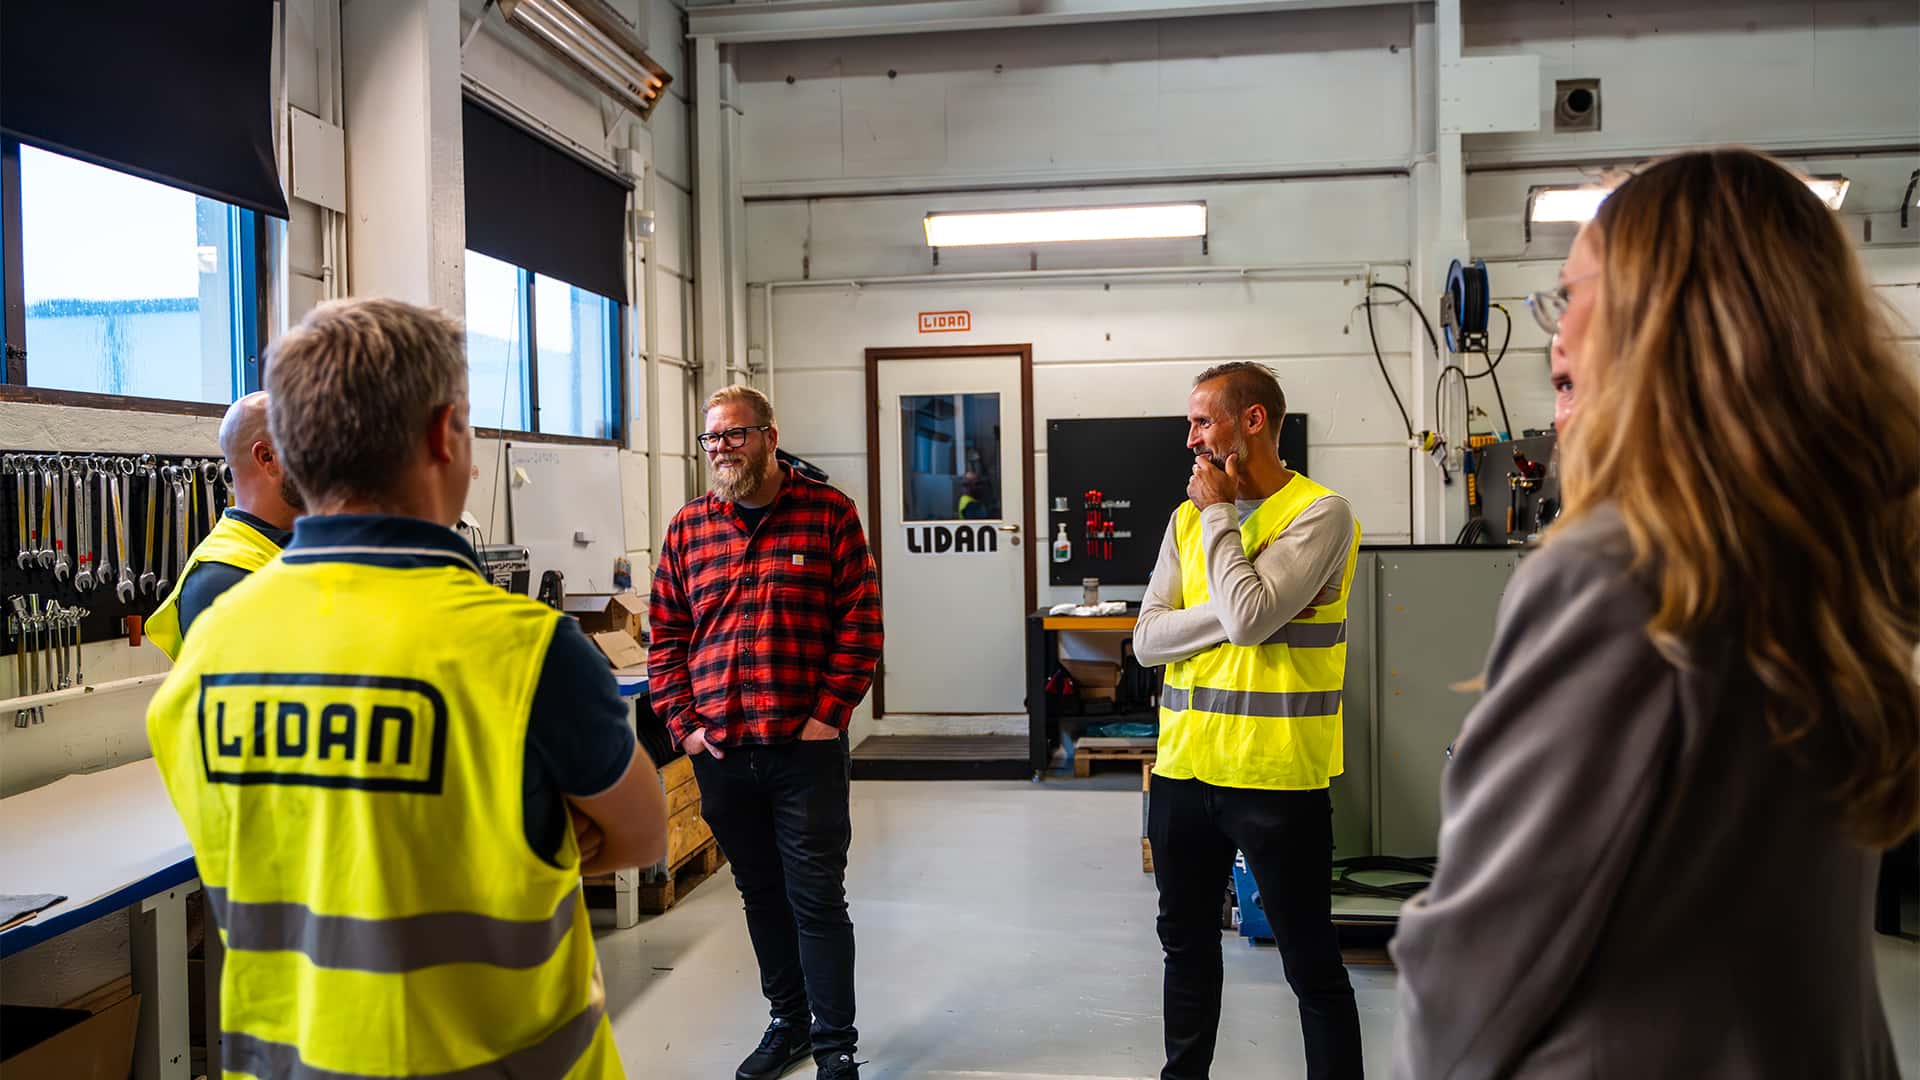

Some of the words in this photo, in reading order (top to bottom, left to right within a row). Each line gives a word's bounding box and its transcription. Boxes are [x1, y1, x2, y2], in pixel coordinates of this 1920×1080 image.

[924, 315, 965, 328] LIDAN
[906, 525, 997, 553] LIDAN
[216, 701, 414, 765] LIDAN
